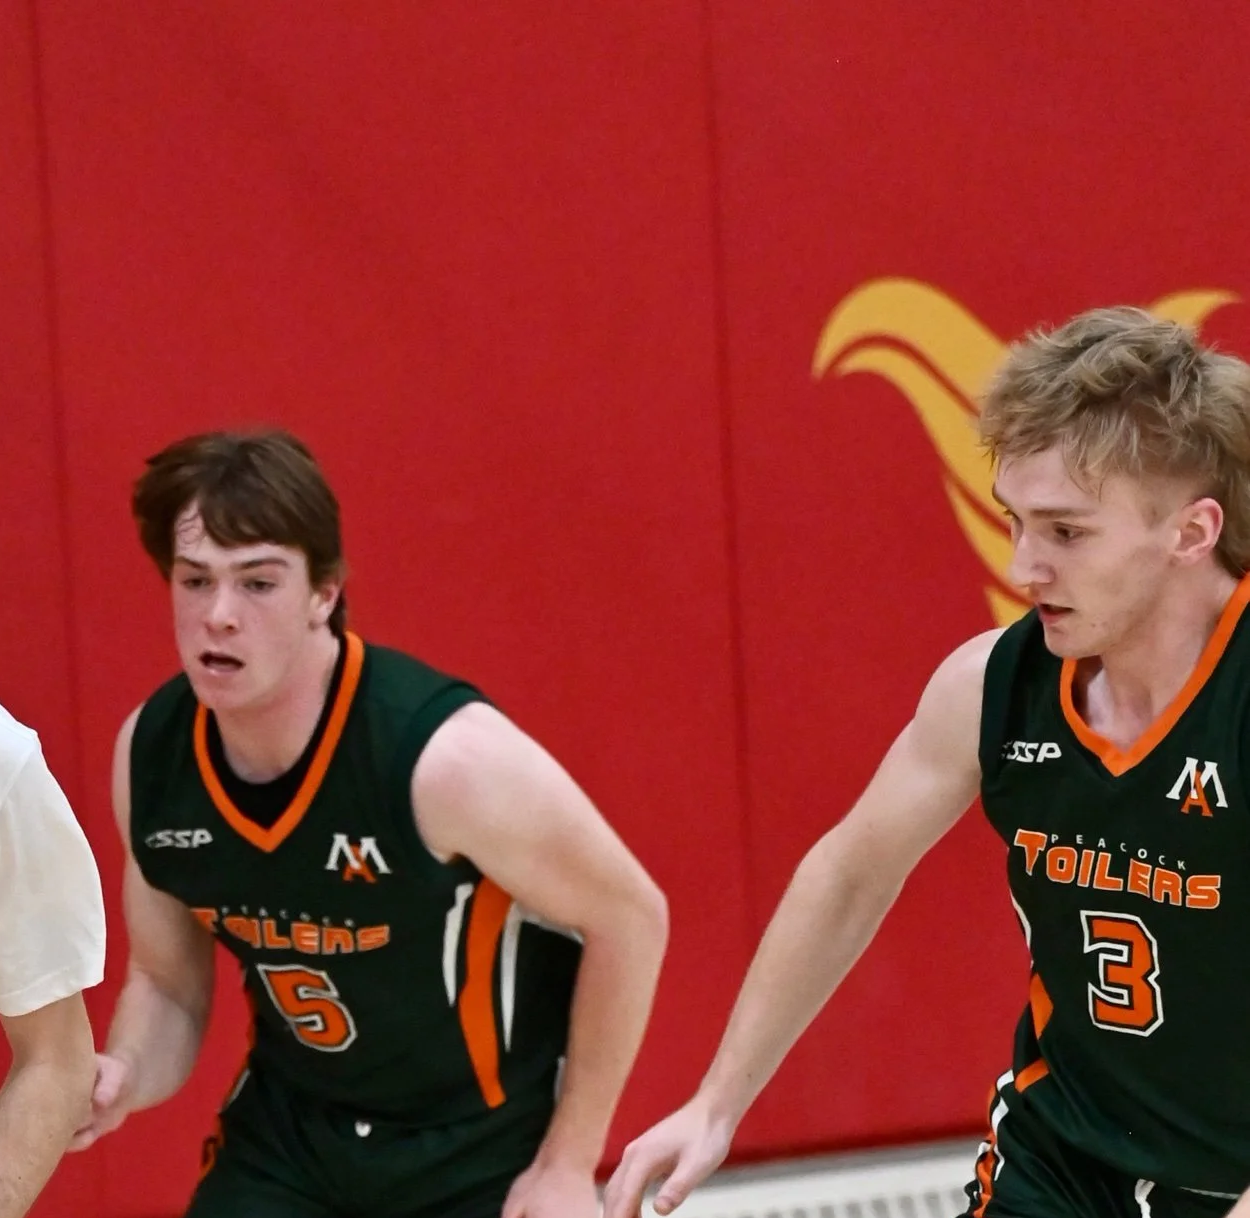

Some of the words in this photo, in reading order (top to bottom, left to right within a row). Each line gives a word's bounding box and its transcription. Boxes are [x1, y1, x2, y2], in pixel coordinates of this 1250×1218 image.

[1014, 829, 1221, 909] TOILERS
[1050, 833, 1187, 871] PEACOCK
[256, 962, 358, 1053] 5
[1080, 910, 1164, 1037] 3
